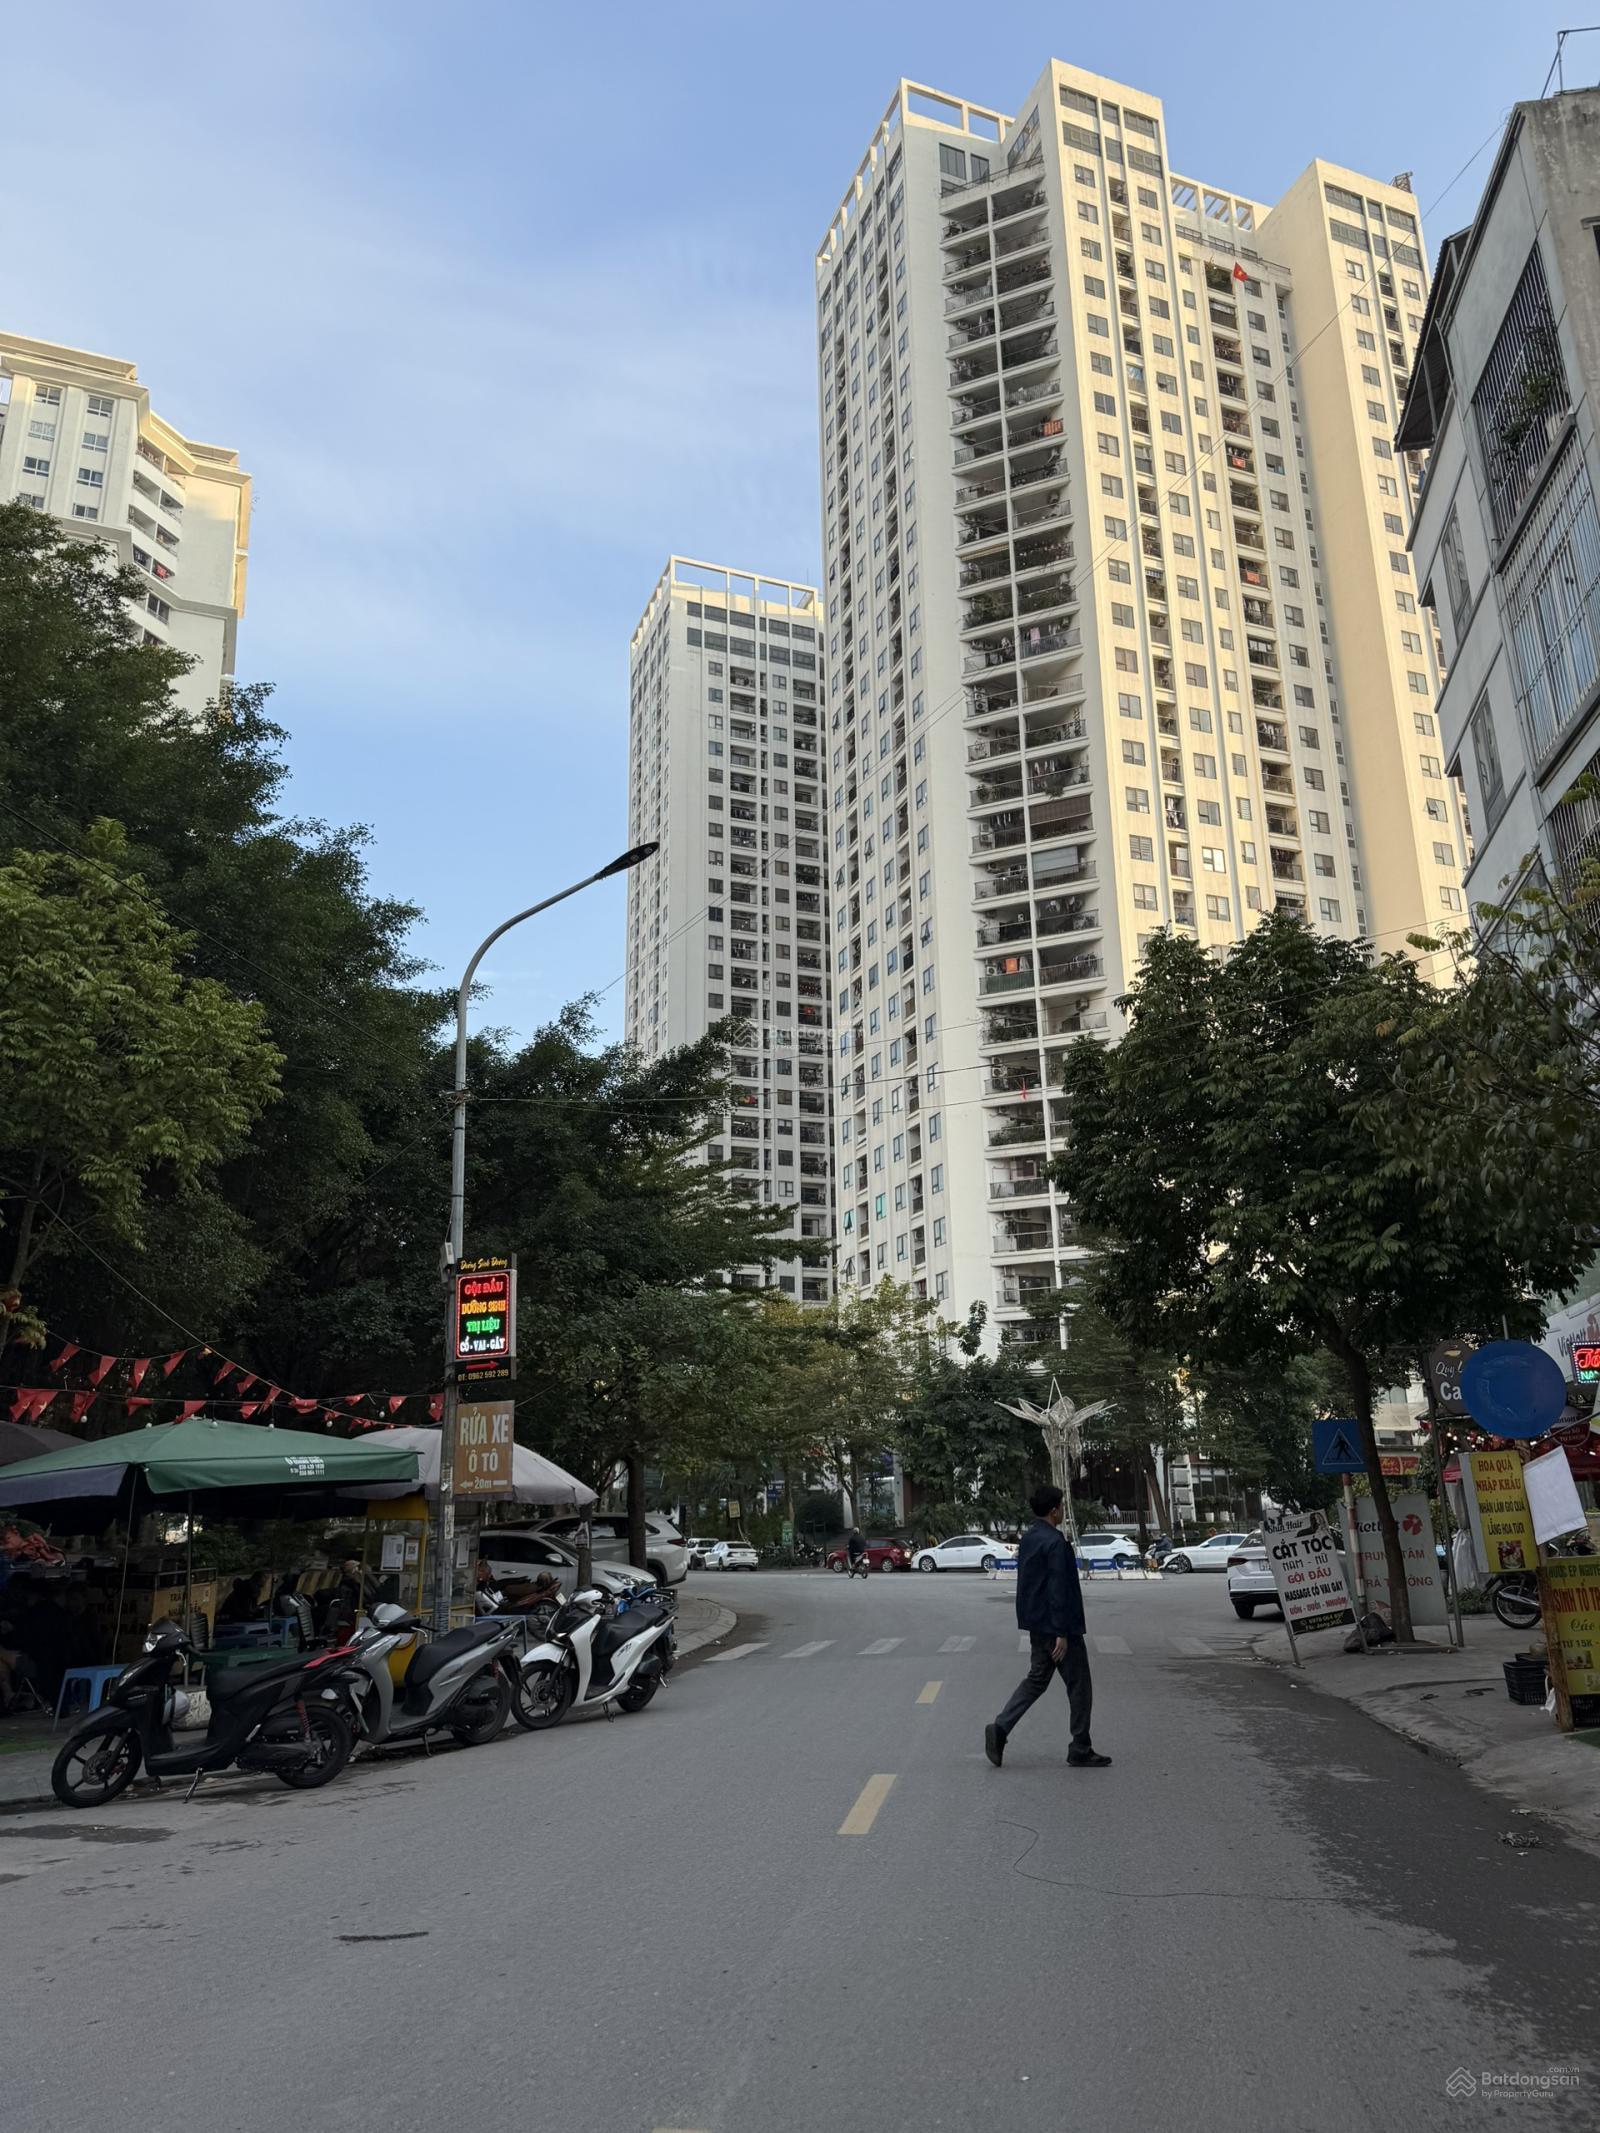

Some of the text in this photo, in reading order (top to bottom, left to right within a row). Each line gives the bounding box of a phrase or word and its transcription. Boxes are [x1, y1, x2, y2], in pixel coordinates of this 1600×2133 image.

[460, 1406, 510, 1446] RỬA XE
[469, 1448, 499, 1473] Ô TÔ
[1478, 1459, 1495, 1473] HOA
[475, 1476, 492, 1489] 20m
[1272, 1534, 1333, 1560] CẮT TÓC
[1282, 1559, 1304, 1571] NAM
[1288, 1572, 1305, 1584] GỘI
[1284, 1587, 1312, 1602] MASSAGE
[1320, 1583, 1332, 1595] VAI
